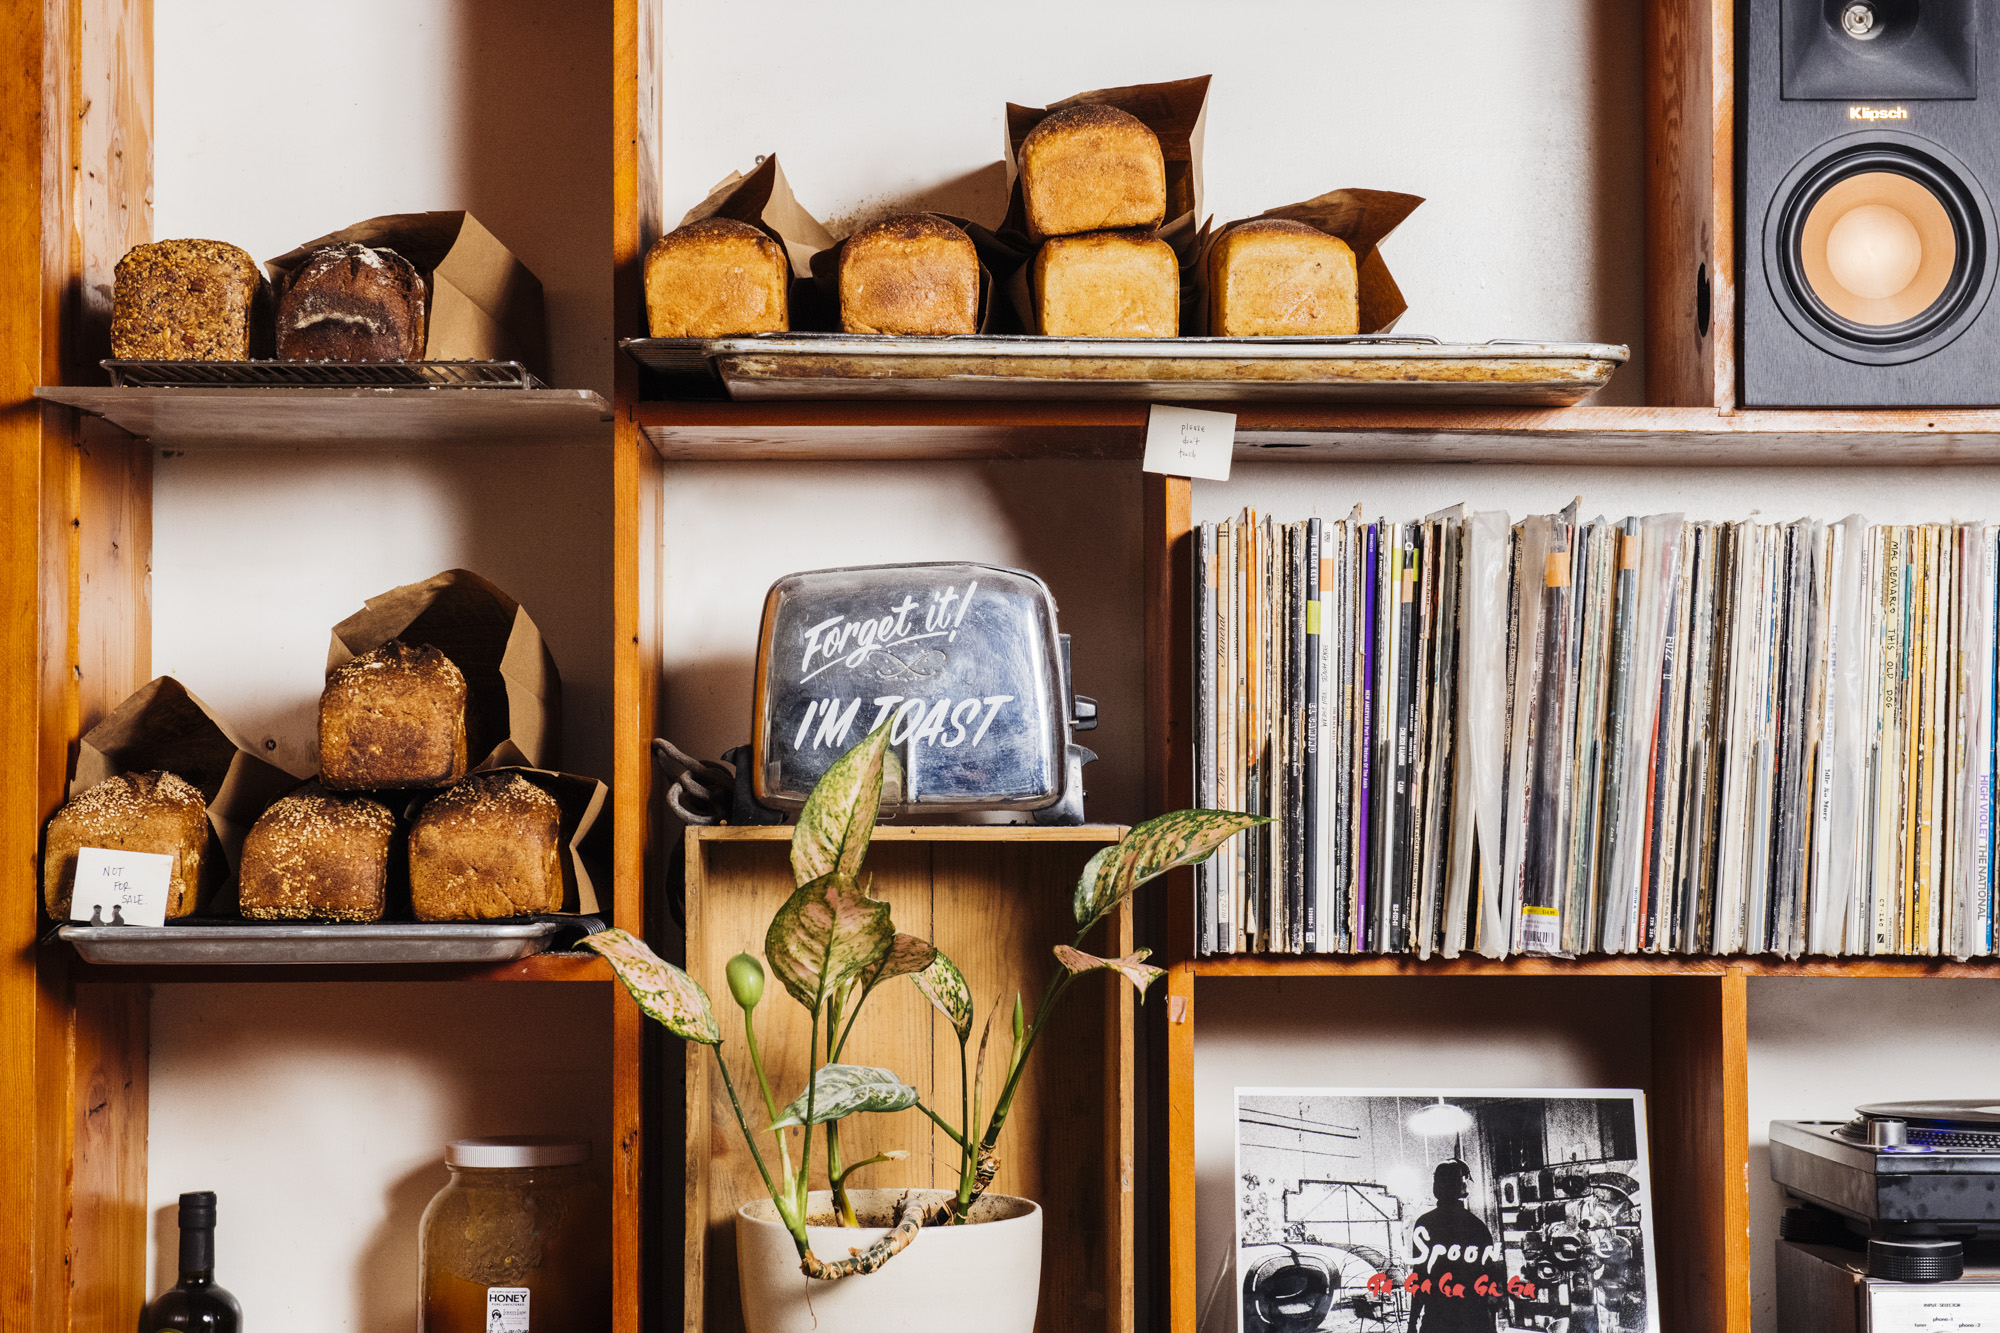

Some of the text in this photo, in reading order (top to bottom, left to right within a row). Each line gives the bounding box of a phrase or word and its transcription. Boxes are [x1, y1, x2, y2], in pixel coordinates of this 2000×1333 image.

[1849, 106, 1908, 122] Klipsch
[1181, 422, 1205, 435] please
[1182, 436, 1200, 445] don't
[1179, 448, 1196, 458] touch
[1890, 566, 1898, 613] DEMARCO
[801, 581, 978, 680] Forget it!
[1887, 629, 1895, 650] THIS
[1665, 636, 1674, 661] FUZZ
[1886, 661, 1894, 679] OLD
[1885, 690, 1893, 708] DOG
[794, 695, 1014, 750] I'M TOAST
[1980, 775, 1988, 800] HIGH
[1979, 803, 1988, 841] VIOLET
[1978, 844, 1987, 863] THE
[102, 866, 125, 877] NOT
[114, 881, 131, 892] FOR
[1977, 866, 1987, 920] NATIONAL
[489, 1294, 527, 1303] HONEY
